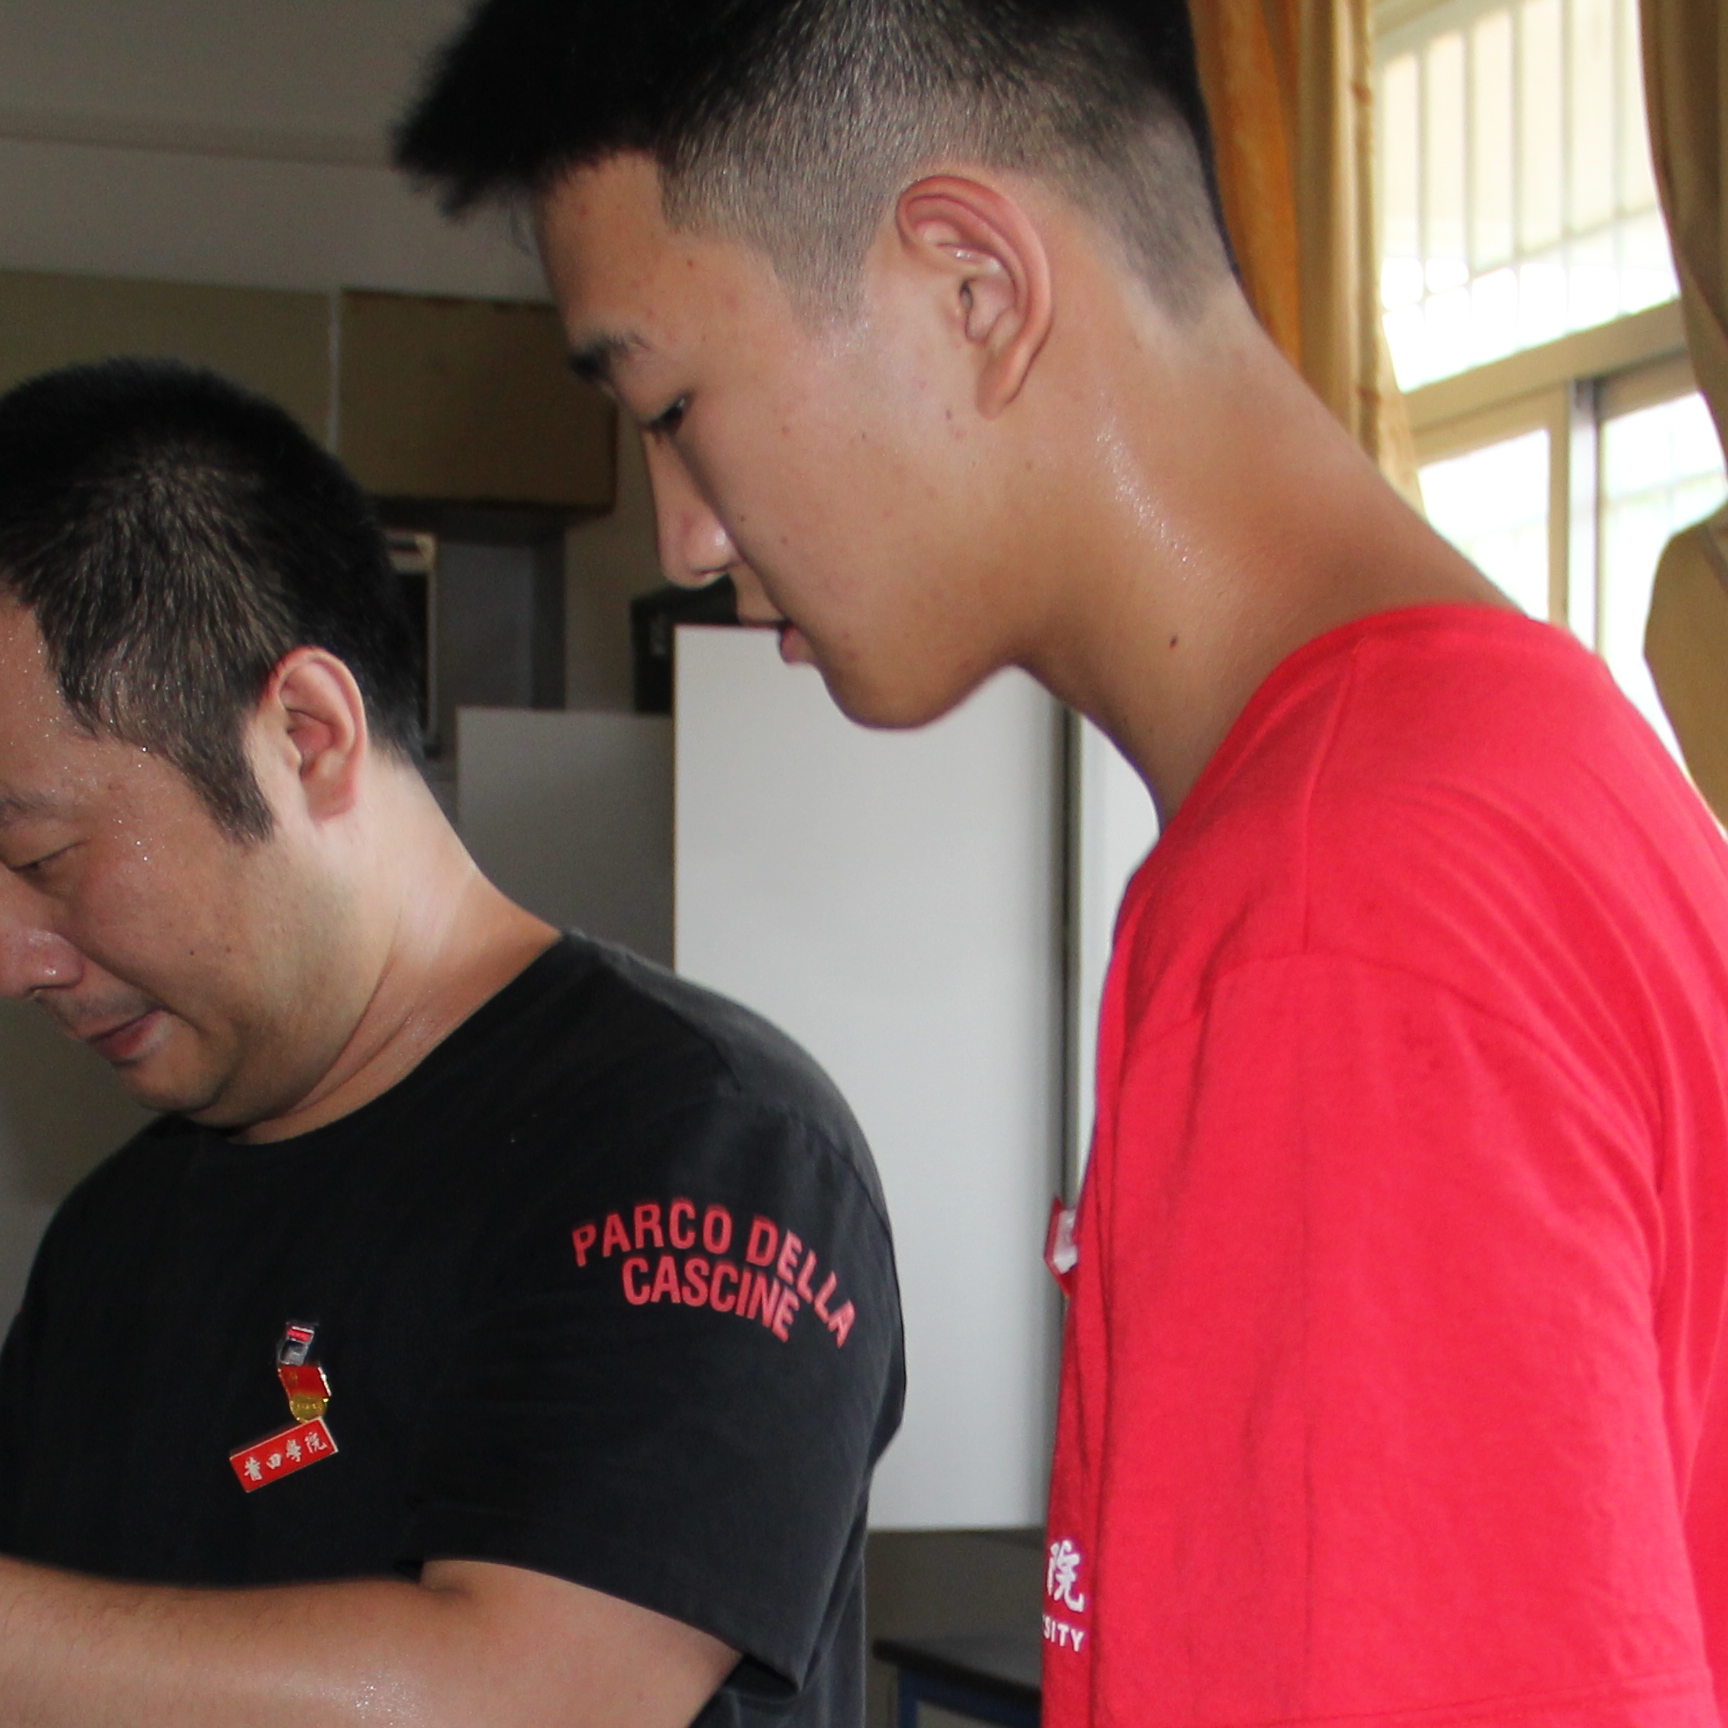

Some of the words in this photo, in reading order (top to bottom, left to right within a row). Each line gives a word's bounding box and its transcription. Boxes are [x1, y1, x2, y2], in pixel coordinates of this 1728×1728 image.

[572, 1197, 732, 1267] PARCO
[745, 1214, 856, 1349] DELLA
[622, 1256, 800, 1343] CASCINE
[1042, 1614, 1085, 1652] SITY
